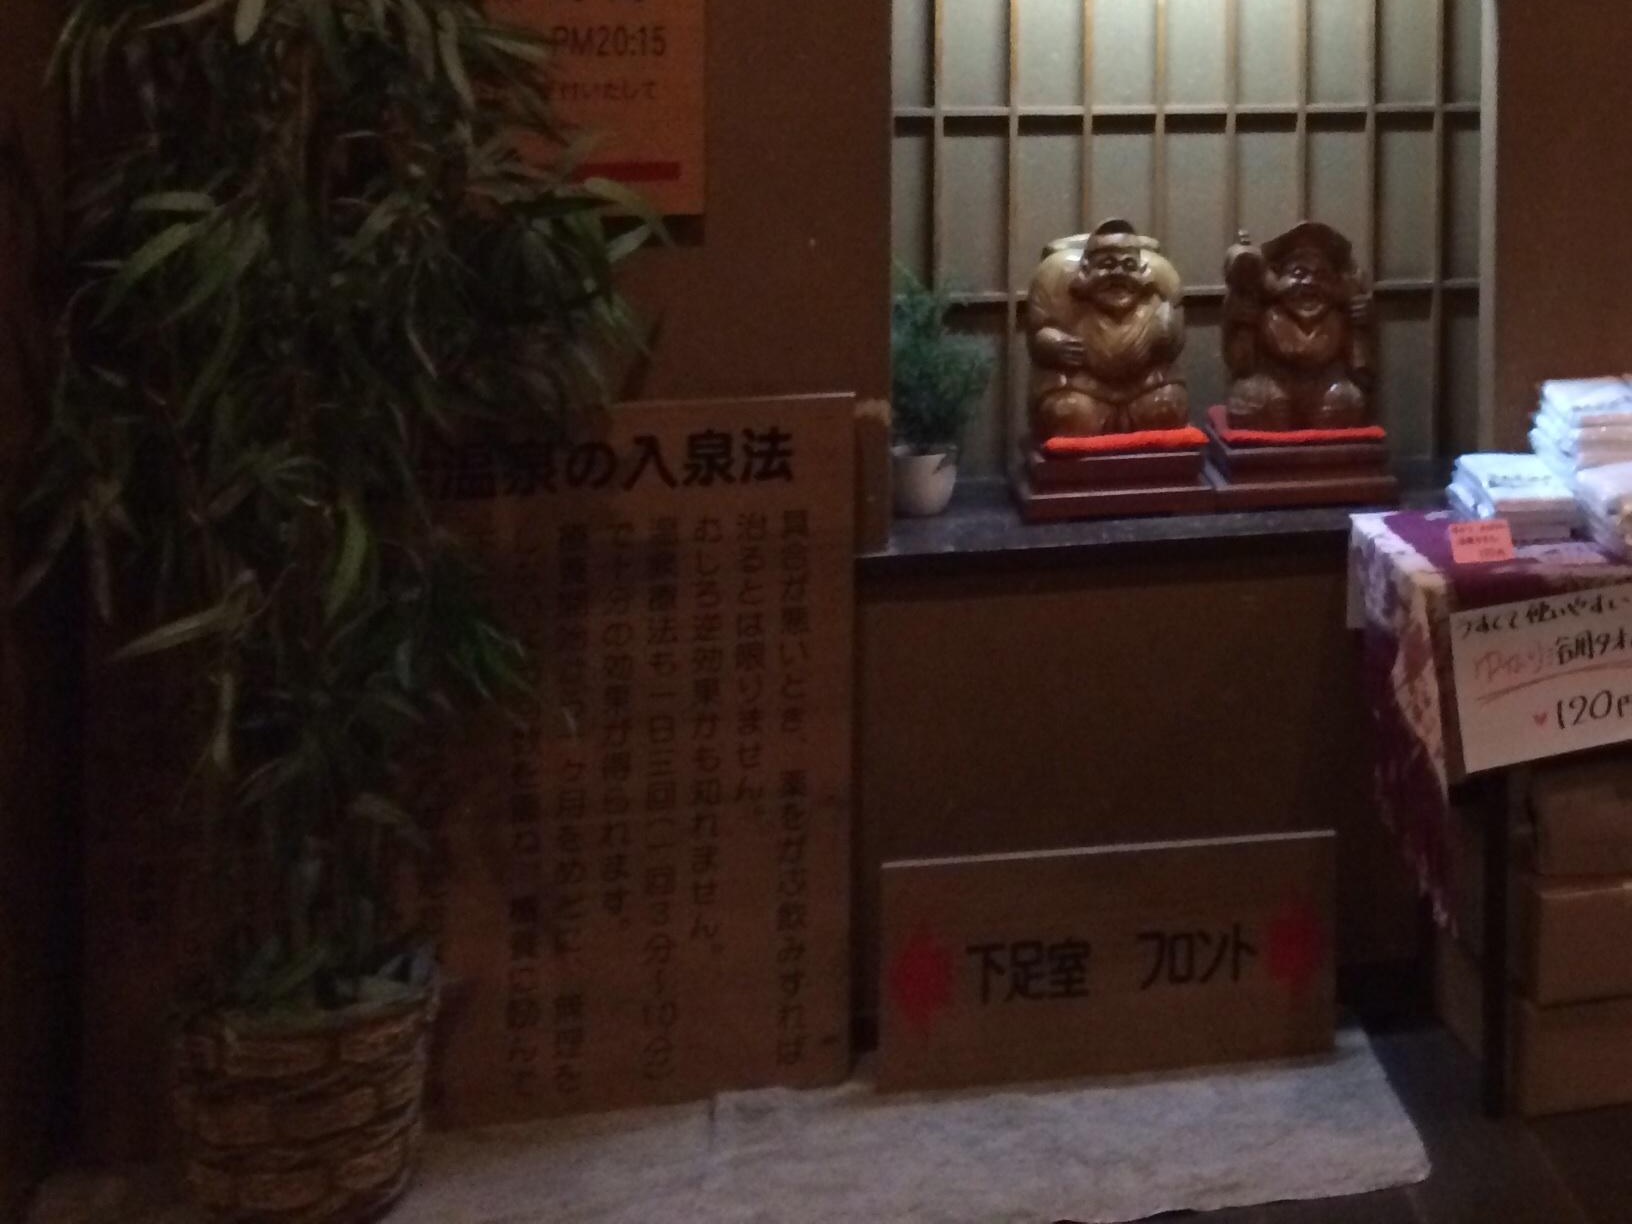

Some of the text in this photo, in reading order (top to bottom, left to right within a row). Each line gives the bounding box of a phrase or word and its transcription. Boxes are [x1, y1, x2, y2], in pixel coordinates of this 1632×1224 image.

[966, 922, 1258, 1005] 下足室 フロント
